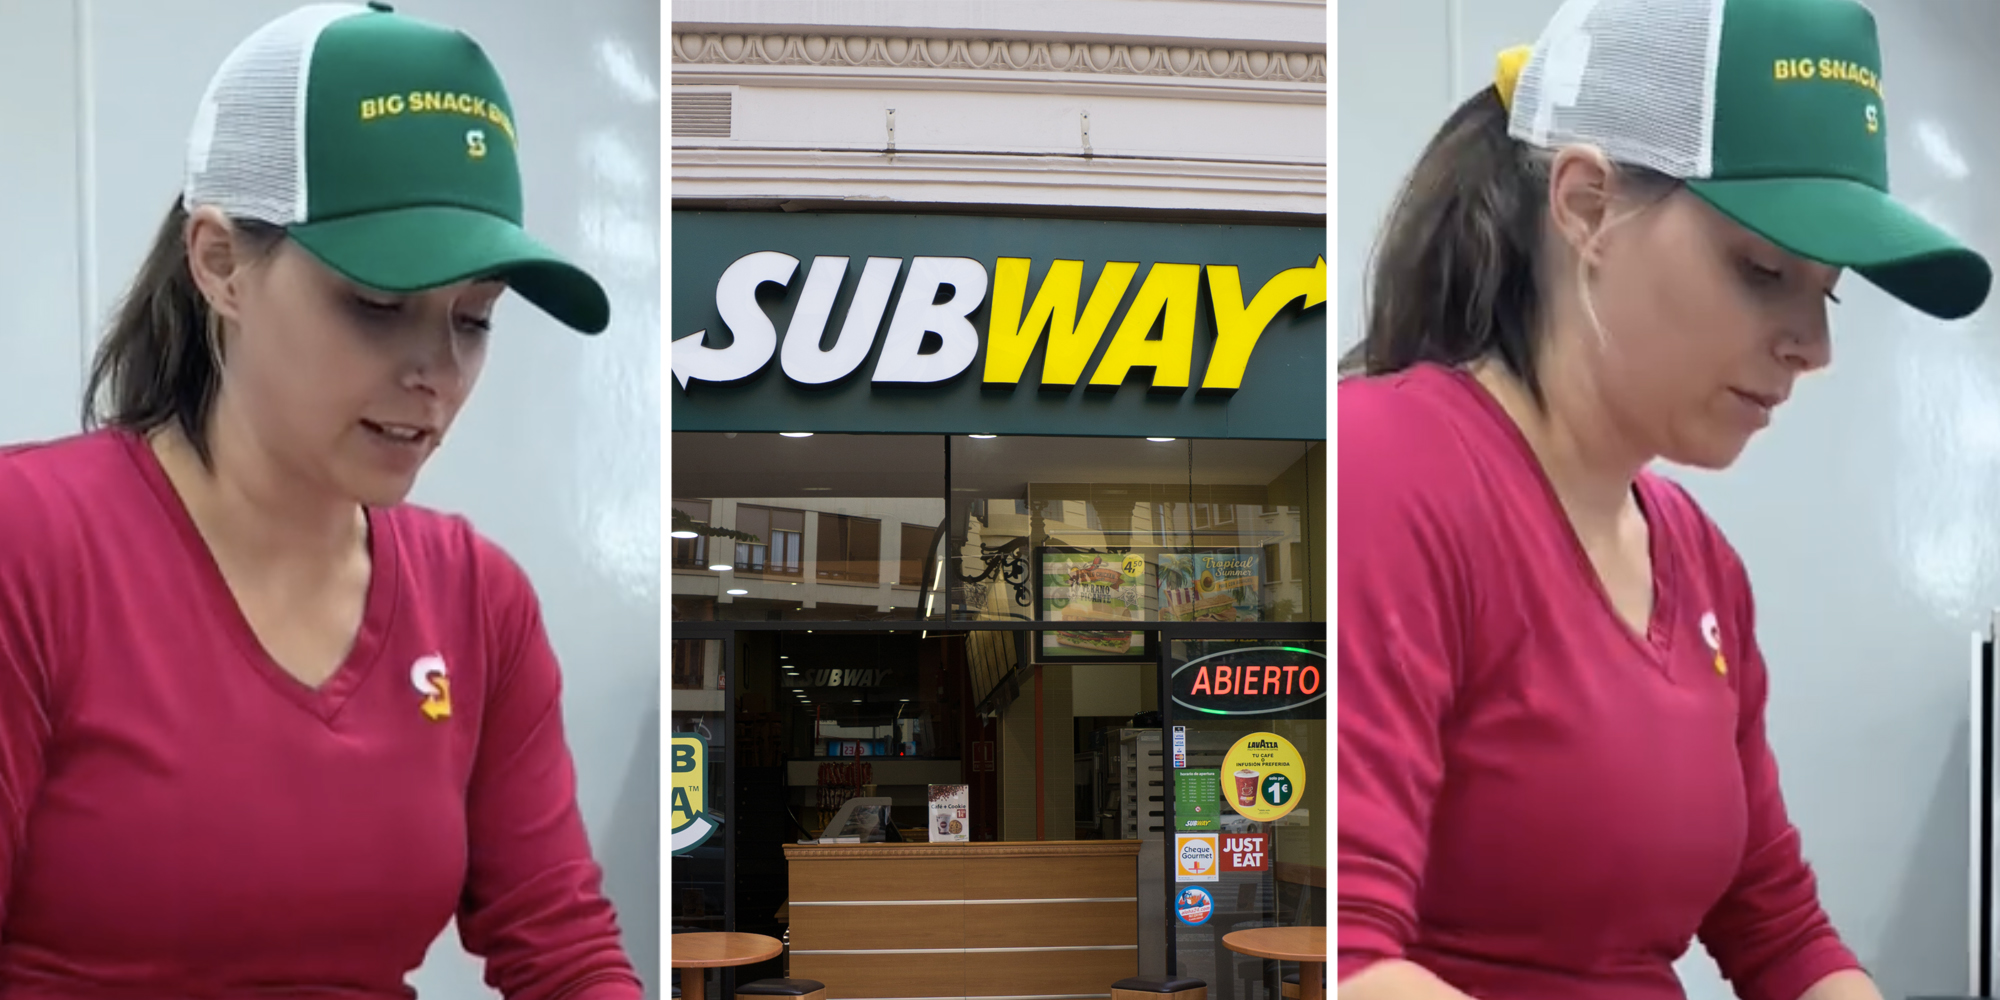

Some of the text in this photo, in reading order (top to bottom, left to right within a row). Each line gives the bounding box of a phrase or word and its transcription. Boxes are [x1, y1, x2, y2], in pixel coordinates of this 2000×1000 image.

[1775, 58, 1816, 79] BIG
[361, 91, 487, 120] BIG SNACK
[466, 130, 487, 158] S
[672, 250, 1327, 394] SUBWAY
[1202, 556, 1254, 569] Tropical
[1215, 568, 1252, 577] Summer
[800, 668, 893, 687] SUBWAY
[1190, 665, 1320, 695] ABIERTO
[1247, 739, 1279, 749] LAVAZZA
[672, 744, 697, 773] B
[1223, 838, 1263, 853] JUST
[1233, 853, 1263, 867] EAT
